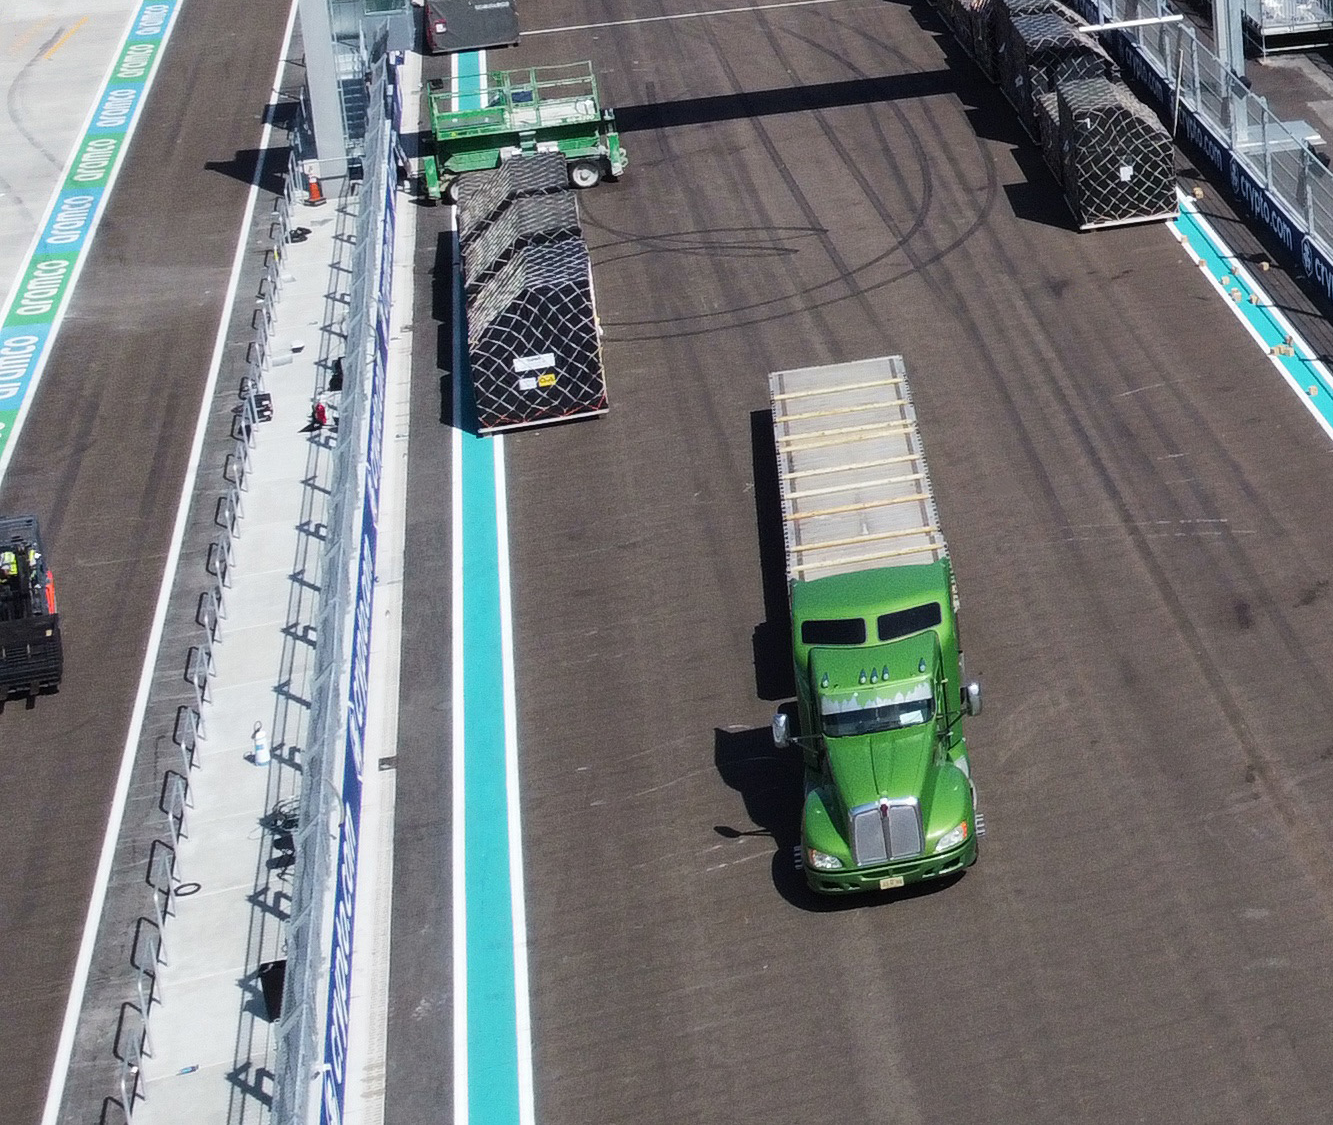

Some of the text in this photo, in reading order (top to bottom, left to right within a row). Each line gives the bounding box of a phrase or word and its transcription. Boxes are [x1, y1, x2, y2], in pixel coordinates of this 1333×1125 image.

[116, 43, 155, 78] aramco
[95, 88, 137, 128] aramco
[72, 138, 118, 182] aramco
[45, 195, 95, 244] aramco
[1240, 174, 1294, 251] crypto.com
[15, 259, 70, 316] aramco
